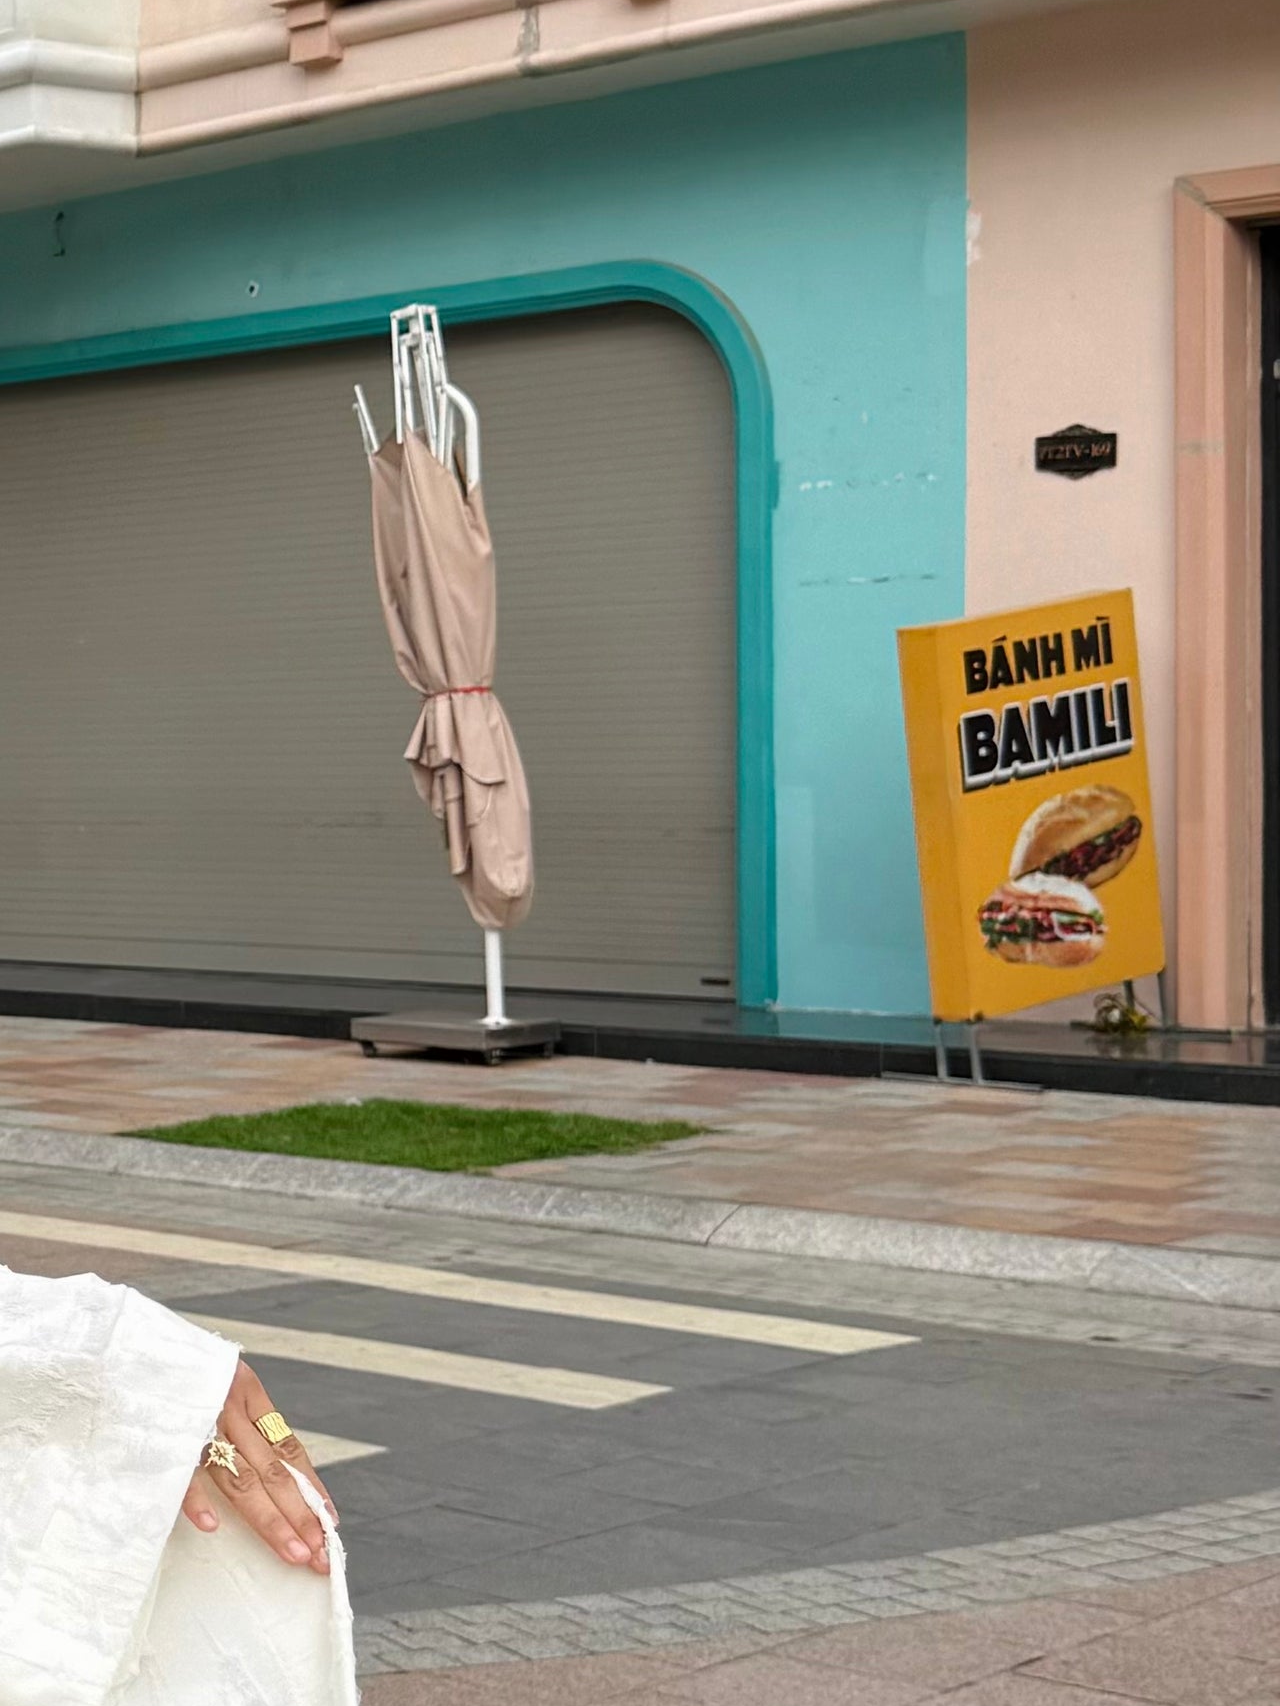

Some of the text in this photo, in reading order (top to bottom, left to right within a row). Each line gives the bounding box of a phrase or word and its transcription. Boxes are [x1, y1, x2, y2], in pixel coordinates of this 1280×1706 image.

[963, 616, 1113, 695] BÁNH MÌ
[958, 677, 1134, 793] BAMILI
